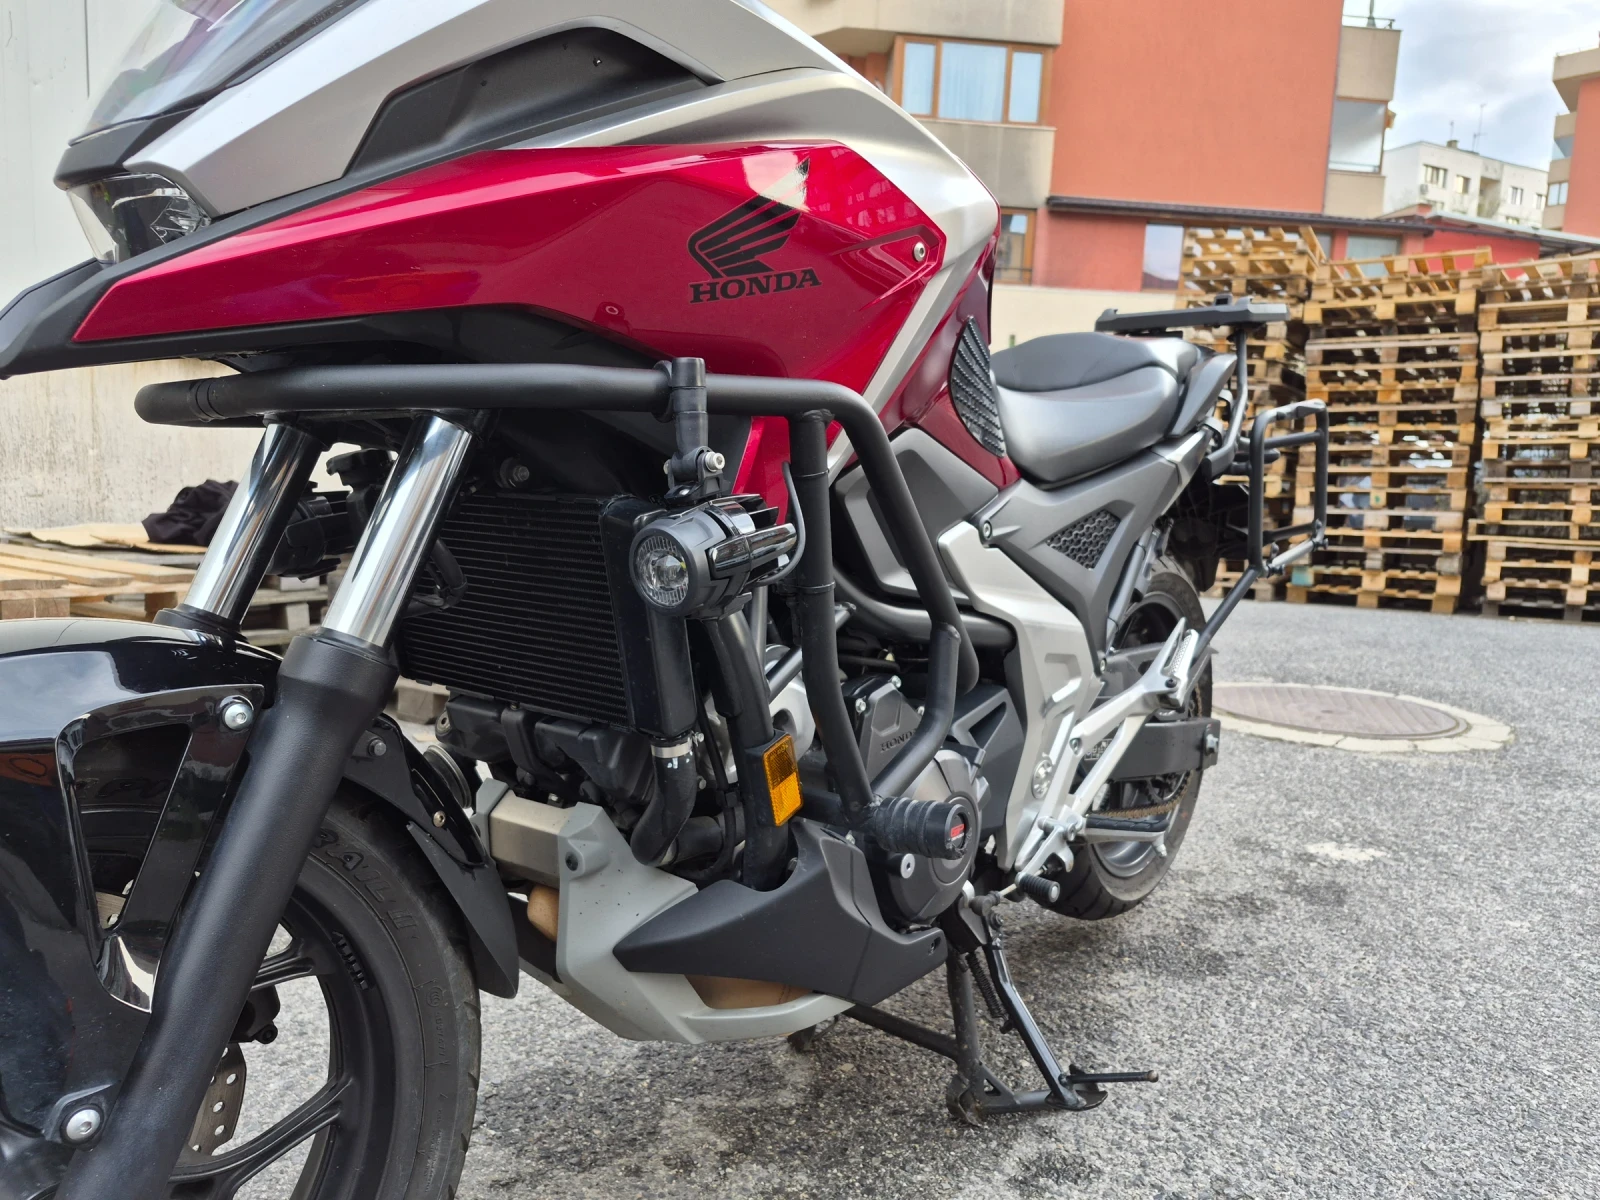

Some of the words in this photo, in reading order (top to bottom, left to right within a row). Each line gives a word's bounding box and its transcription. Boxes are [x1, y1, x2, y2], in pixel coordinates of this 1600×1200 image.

[689, 268, 822, 304] HONDA
[880, 728, 917, 752] HOND
[314, 828, 391, 902] RAIL
